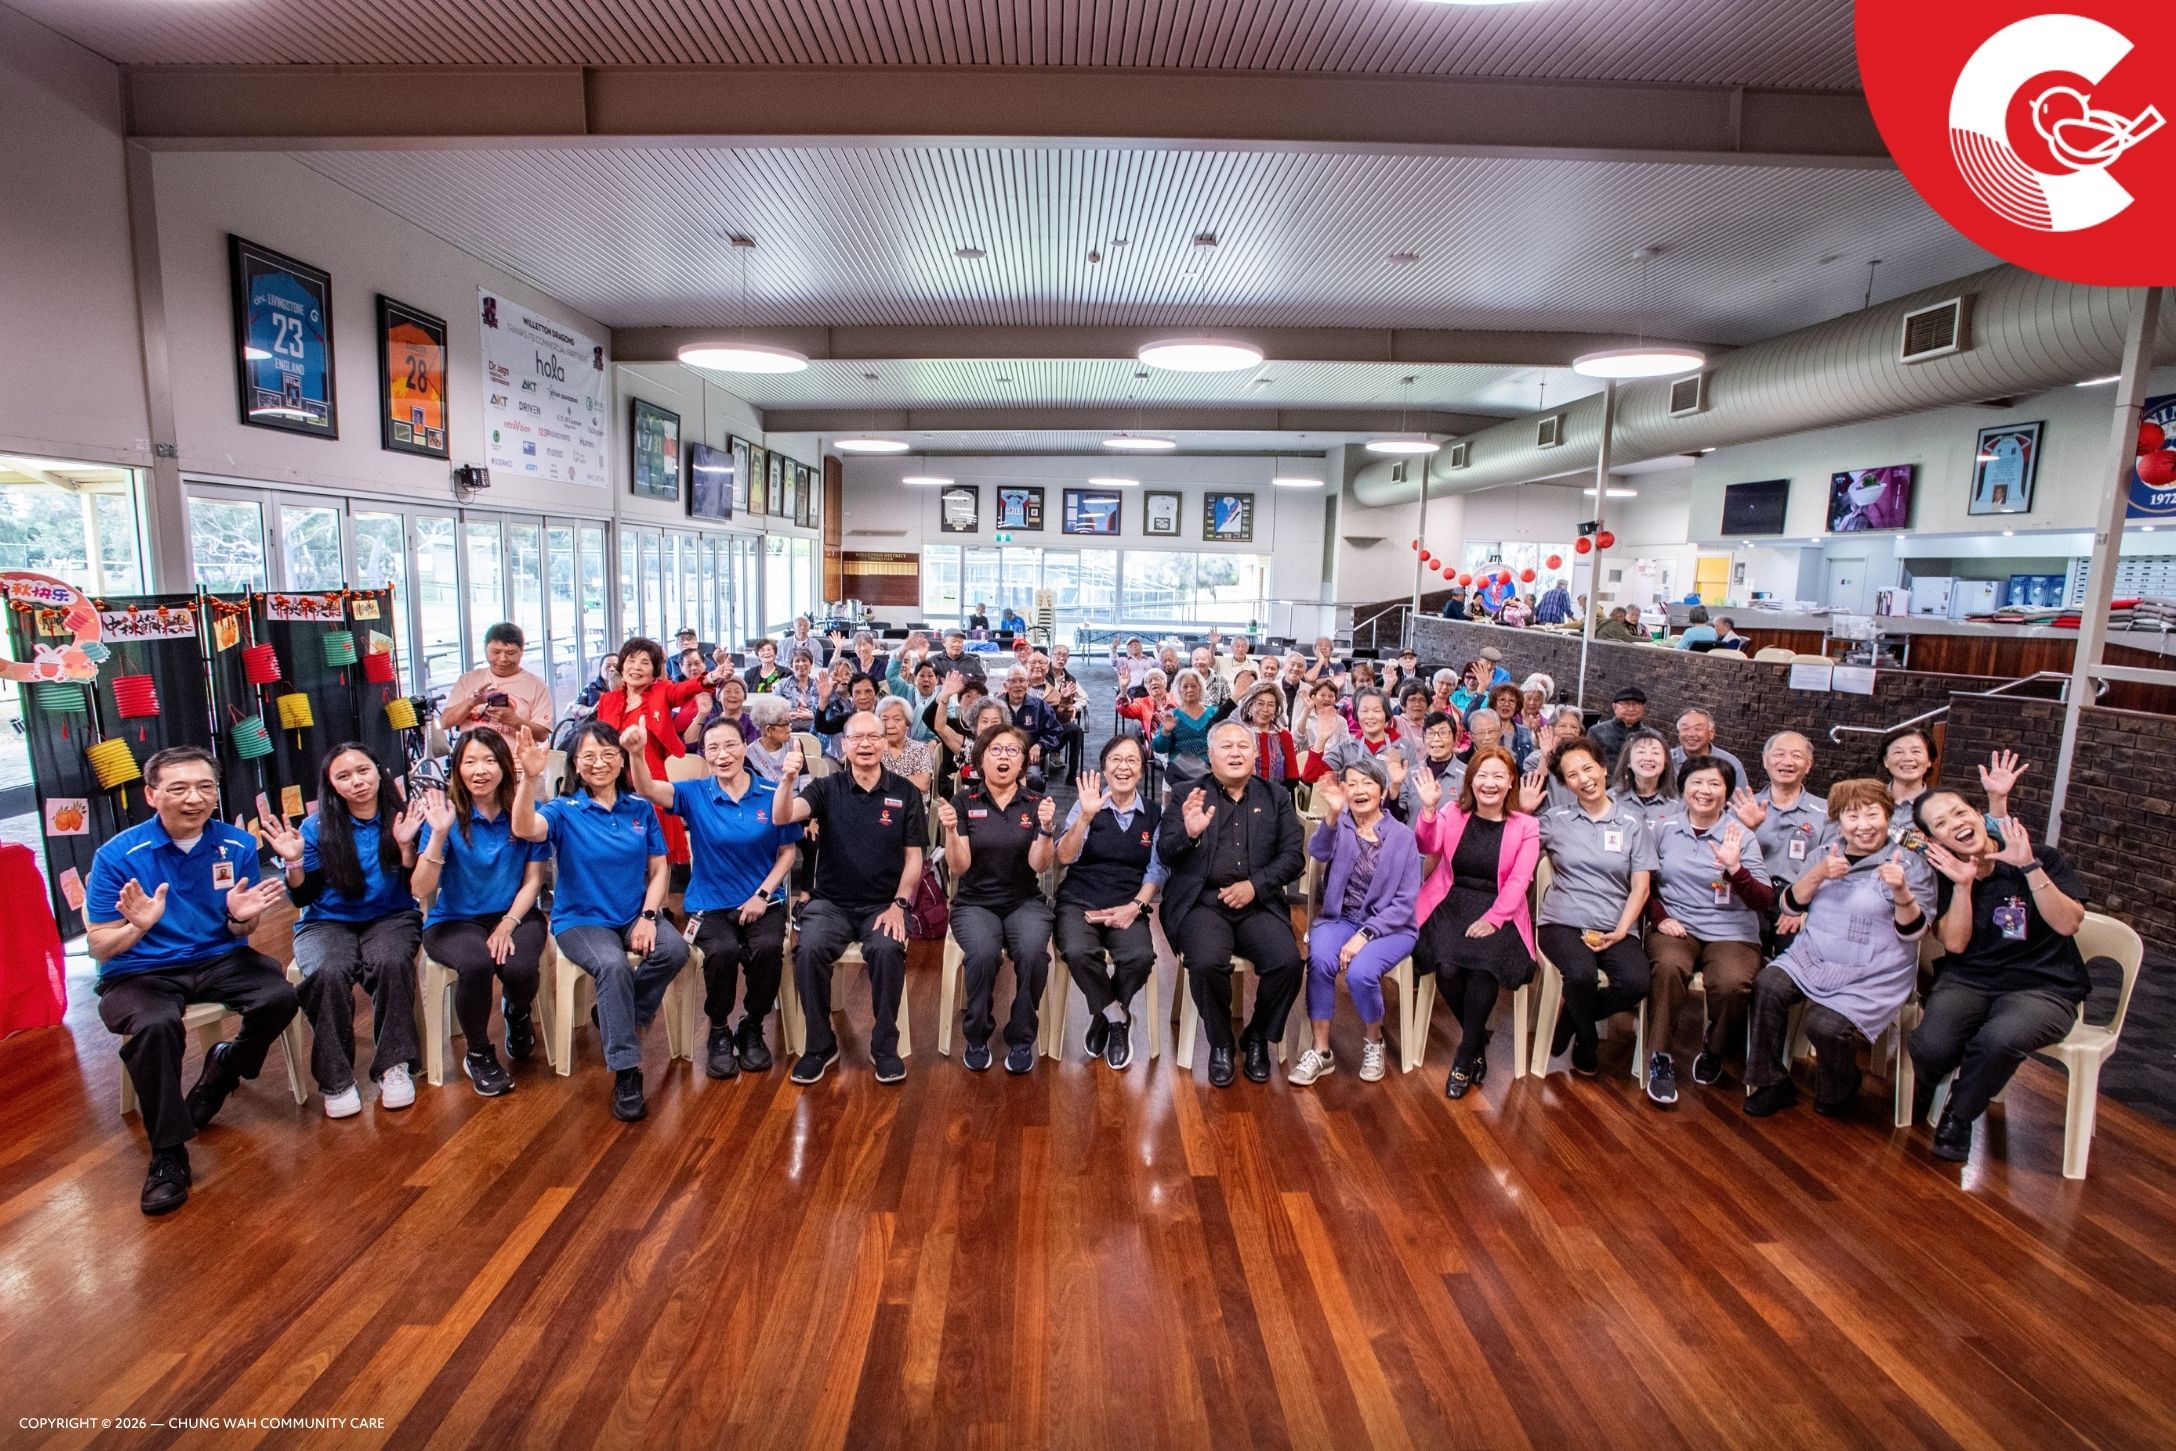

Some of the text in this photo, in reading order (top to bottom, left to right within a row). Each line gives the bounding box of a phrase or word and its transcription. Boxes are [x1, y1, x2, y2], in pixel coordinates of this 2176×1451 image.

[267, 293, 305, 316] LIVINGSTONE
[272, 312, 305, 359] 23
[522, 316, 575, 346] WILLETTON DRAGONS
[274, 356, 305, 376] ENGLAND
[405, 355, 428, 393] 28
[535, 350, 565, 382] hola
[518, 401, 541, 416] DRIVEN
